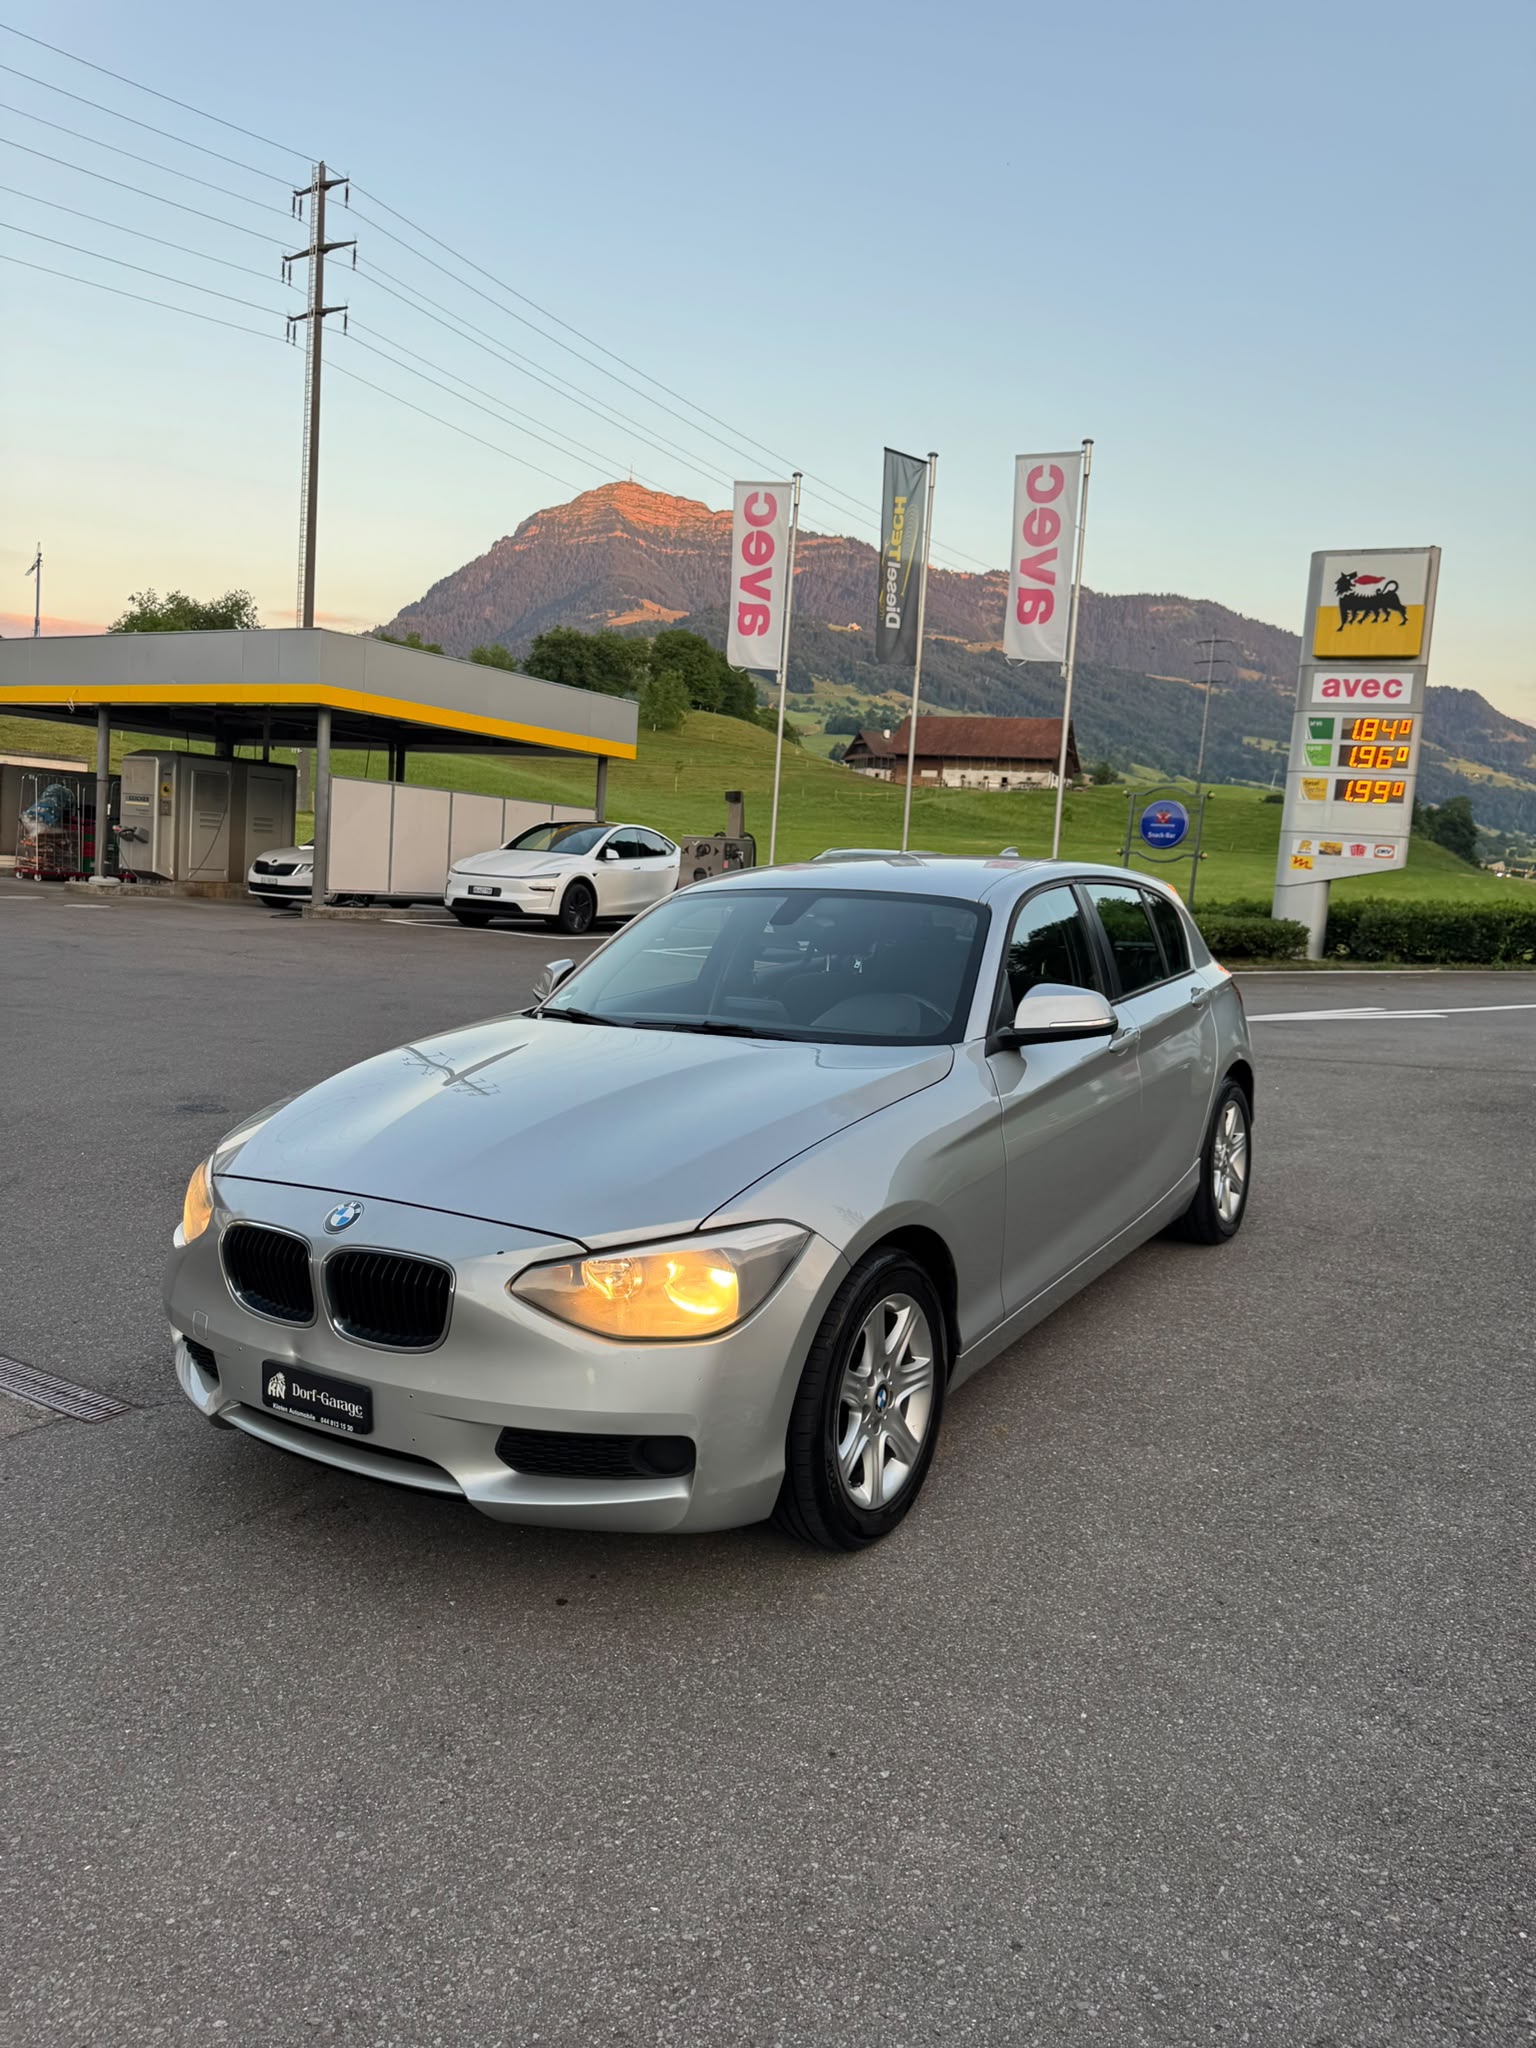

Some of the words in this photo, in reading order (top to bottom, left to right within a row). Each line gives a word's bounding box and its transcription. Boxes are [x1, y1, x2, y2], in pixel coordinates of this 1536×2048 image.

[1321, 678, 1403, 699] avec
[292, 1383, 362, 1417] Dorf-Garage
[289, 1408, 315, 1420] Automobile
